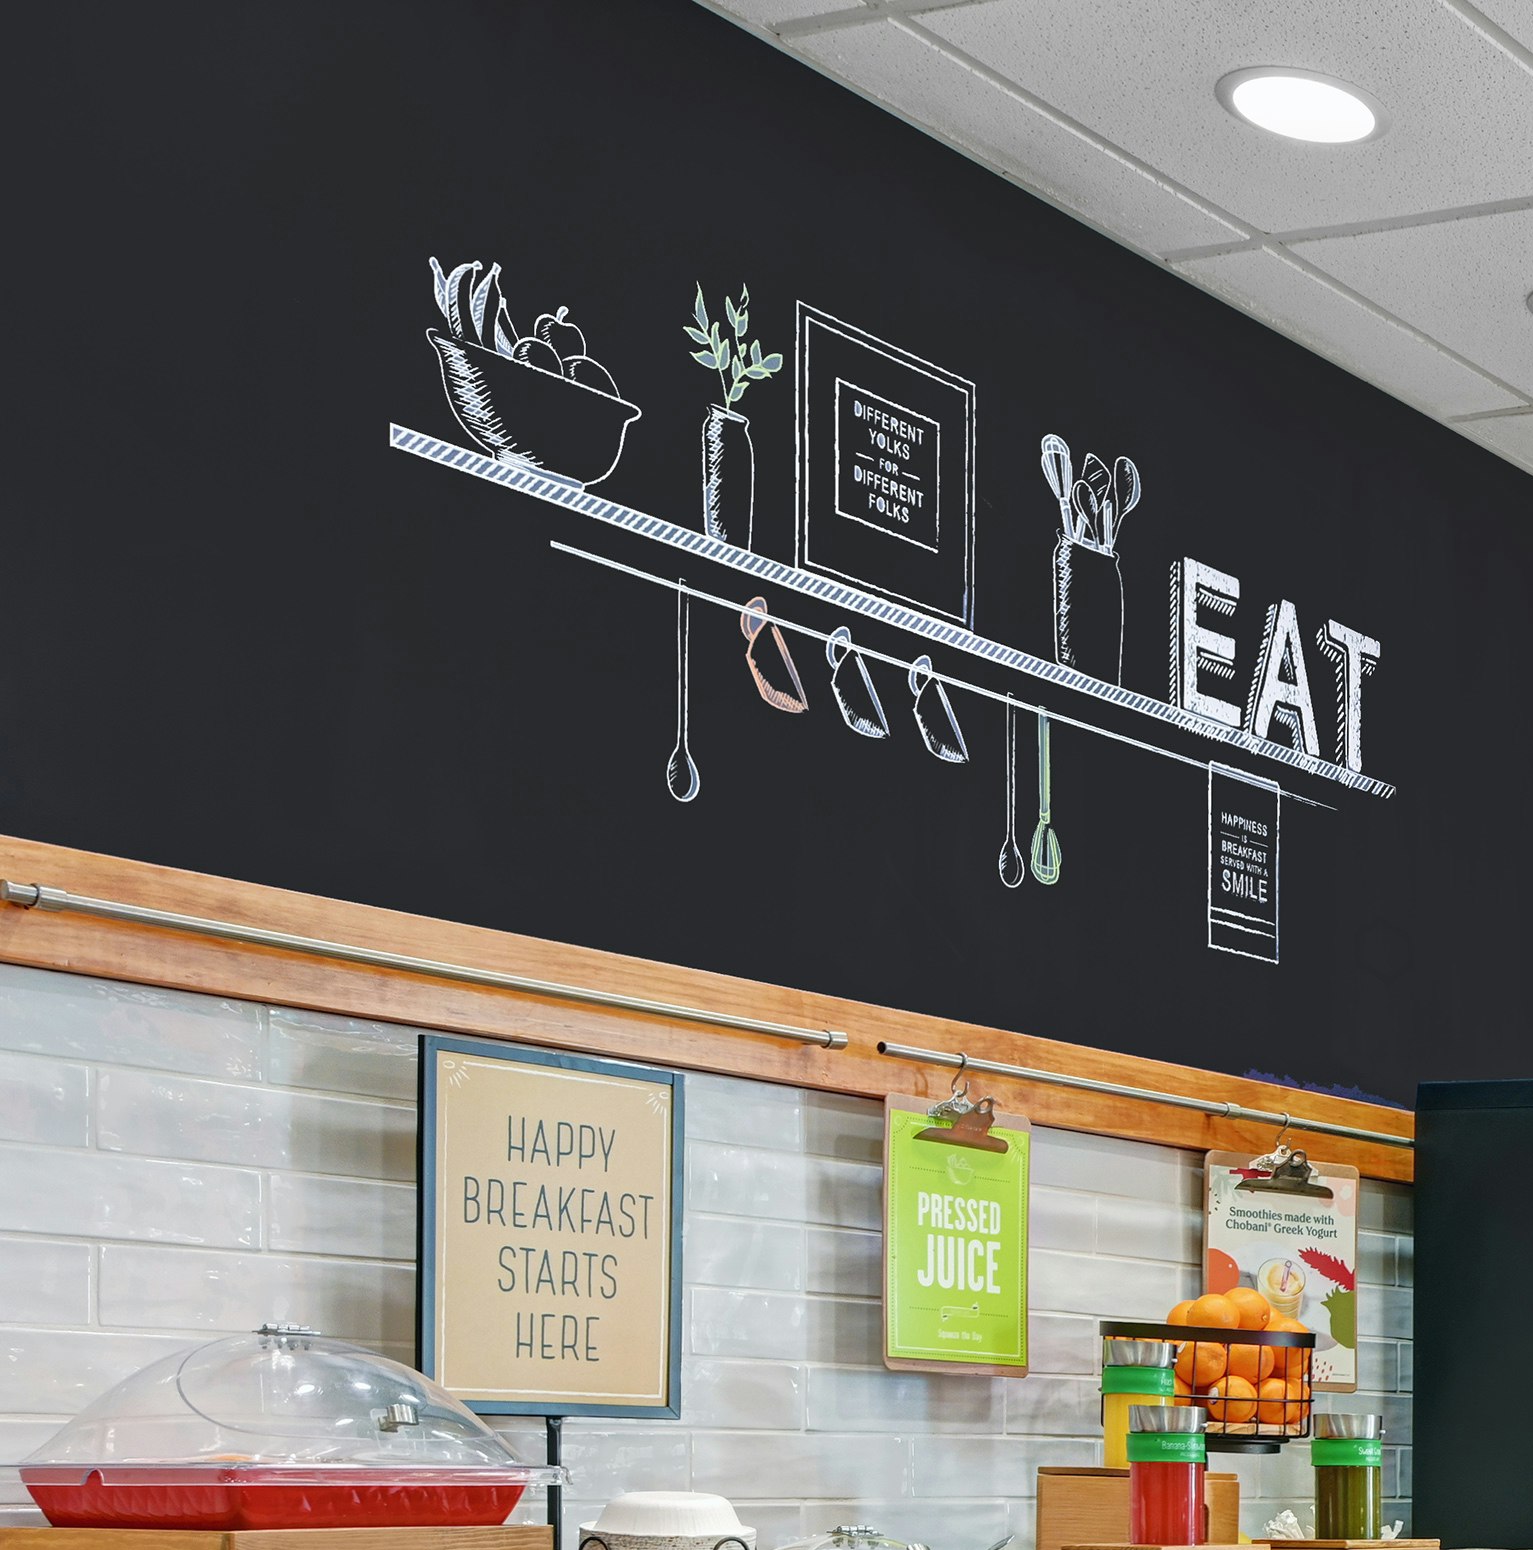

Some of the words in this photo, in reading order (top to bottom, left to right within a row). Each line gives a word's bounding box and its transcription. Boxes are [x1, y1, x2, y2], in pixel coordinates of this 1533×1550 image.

[854, 400, 924, 446] DIFFERENT
[868, 428, 910, 460] YOLKS
[879, 458, 899, 477] FOR
[854, 464, 924, 508] DIFFERENT
[868, 493, 910, 524] FOLKS
[1168, 556, 1381, 774] EAT
[1221, 811, 1268, 837] HAPPINESS
[1241, 835, 1248, 844] IS
[1220, 855, 1245, 870] SERVED
[1246, 863, 1262, 876] WITH
[1263, 868, 1269, 877] A
[1221, 839, 1267, 864] BREAKFAST
[1221, 869, 1268, 903] SMILE
[507, 1115, 615, 1173] HAPPY
[463, 1175, 654, 1239] BREAKFAST
[917, 1191, 1001, 1236] PRESSED
[1229, 1206, 1283, 1221] Smoothies
[1284, 1213, 1312, 1224] made
[1313, 1215, 1335, 1226] with
[1273, 1223, 1304, 1236] Greek
[1306, 1226, 1338, 1240] Yogurt
[497, 1245, 618, 1299] STARTS
[917, 1233, 1001, 1295] JUICE
[515, 1312, 600, 1362] HERE
